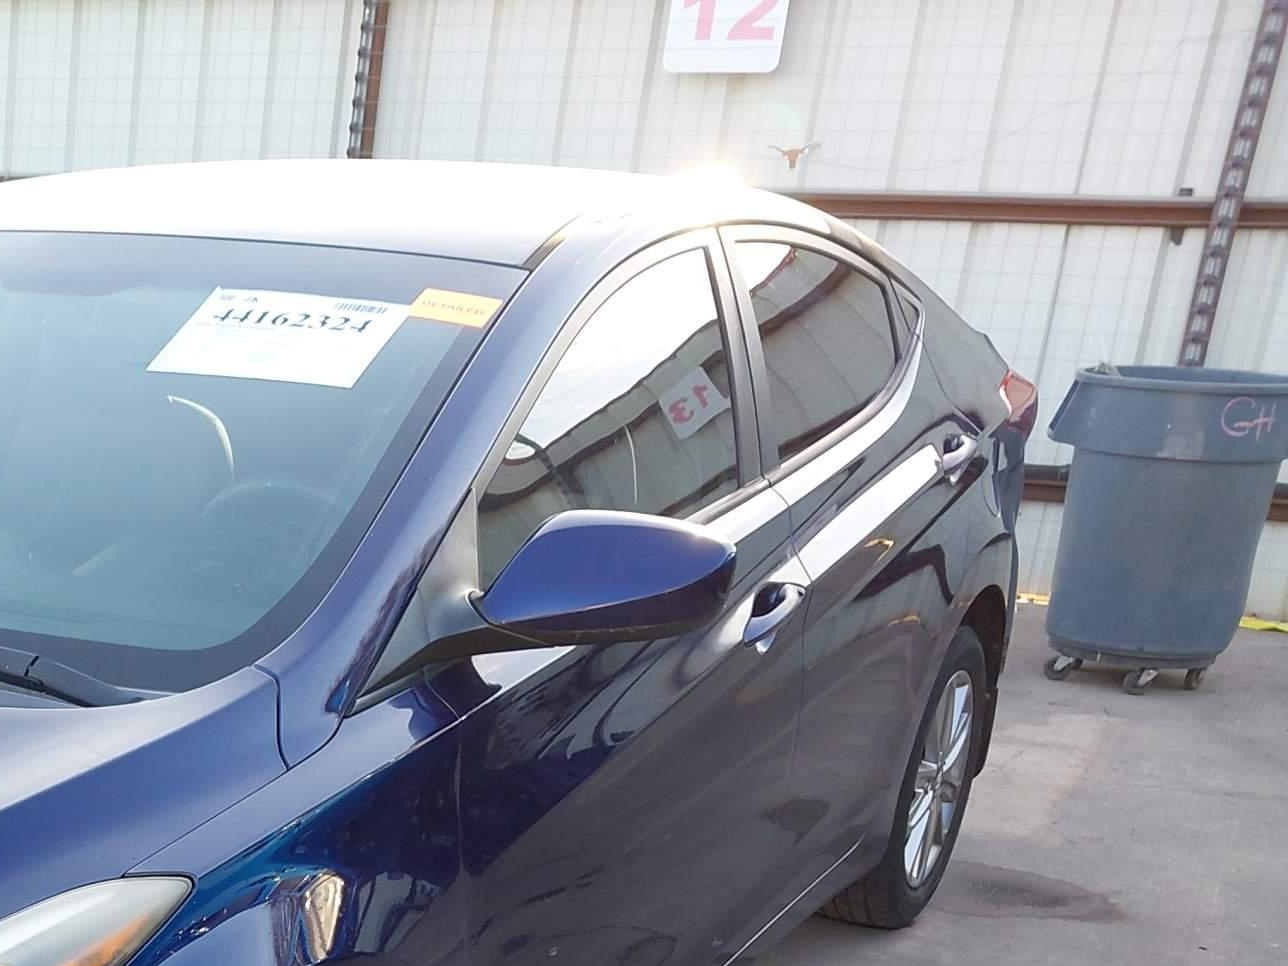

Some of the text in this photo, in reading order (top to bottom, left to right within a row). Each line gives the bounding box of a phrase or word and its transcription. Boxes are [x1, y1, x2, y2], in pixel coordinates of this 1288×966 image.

[682, 0, 778, 41] 12
[213, 308, 372, 333] 44162324
[1220, 396, 1277, 442] GH
